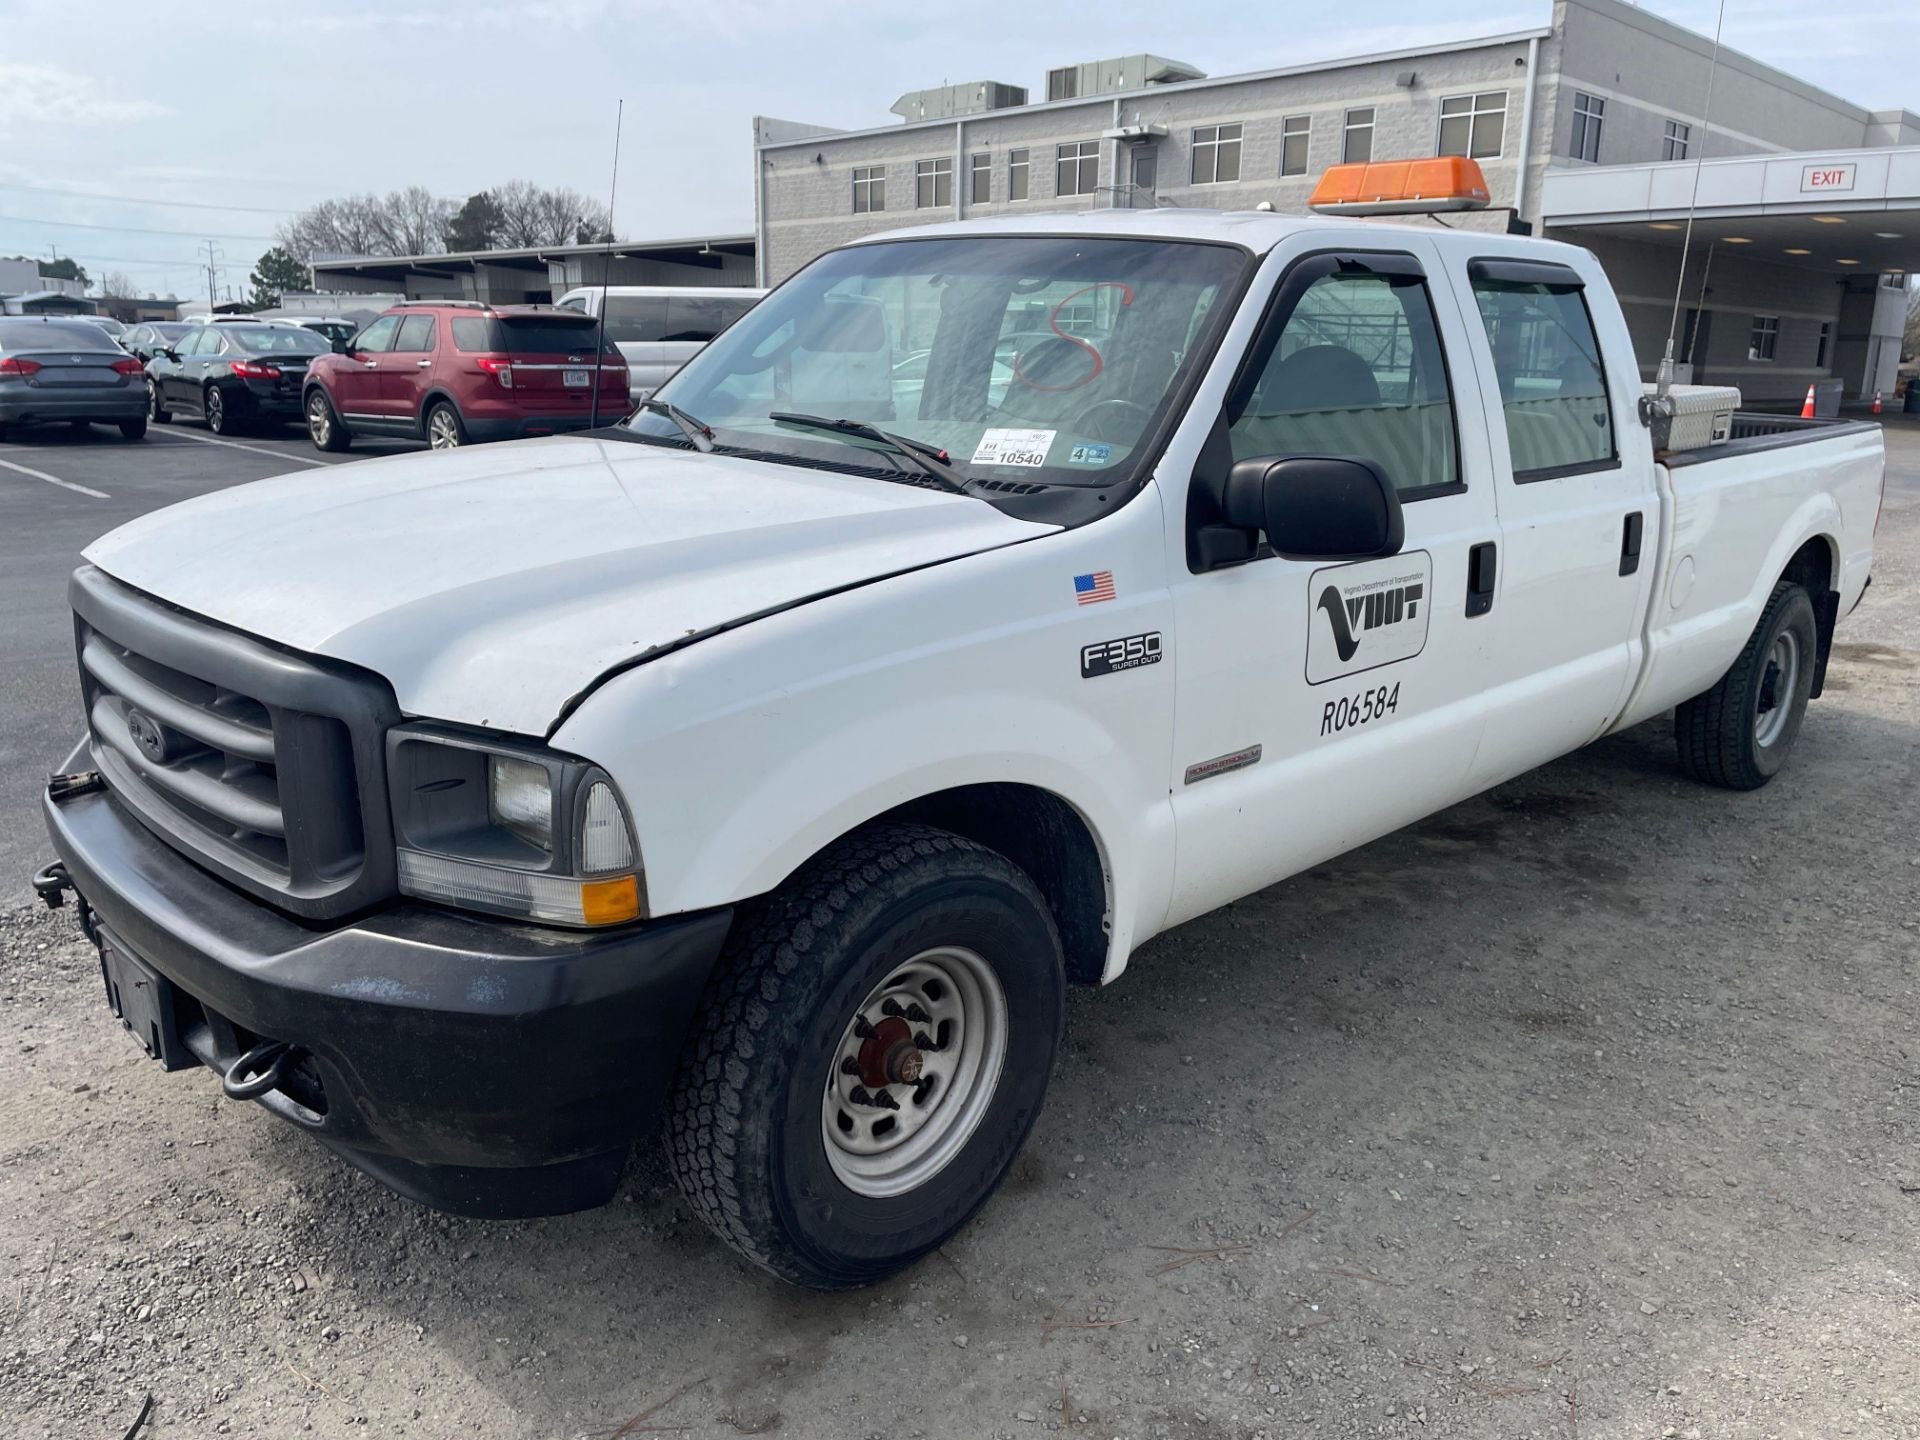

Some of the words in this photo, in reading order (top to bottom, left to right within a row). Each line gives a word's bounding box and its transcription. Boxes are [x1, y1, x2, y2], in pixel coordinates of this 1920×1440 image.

[1811, 170, 1845, 186] EXIT
[1000, 452, 1044, 465] 10540
[1074, 448, 1084, 460] 4
[1344, 585, 1361, 595] Virginia
[1362, 579, 1389, 592] Department
[1394, 572, 1424, 584] Transportation
[1111, 658, 1139, 671] SUPER
[1140, 653, 1162, 664] DUTY
[1320, 681, 1401, 737] R06584
